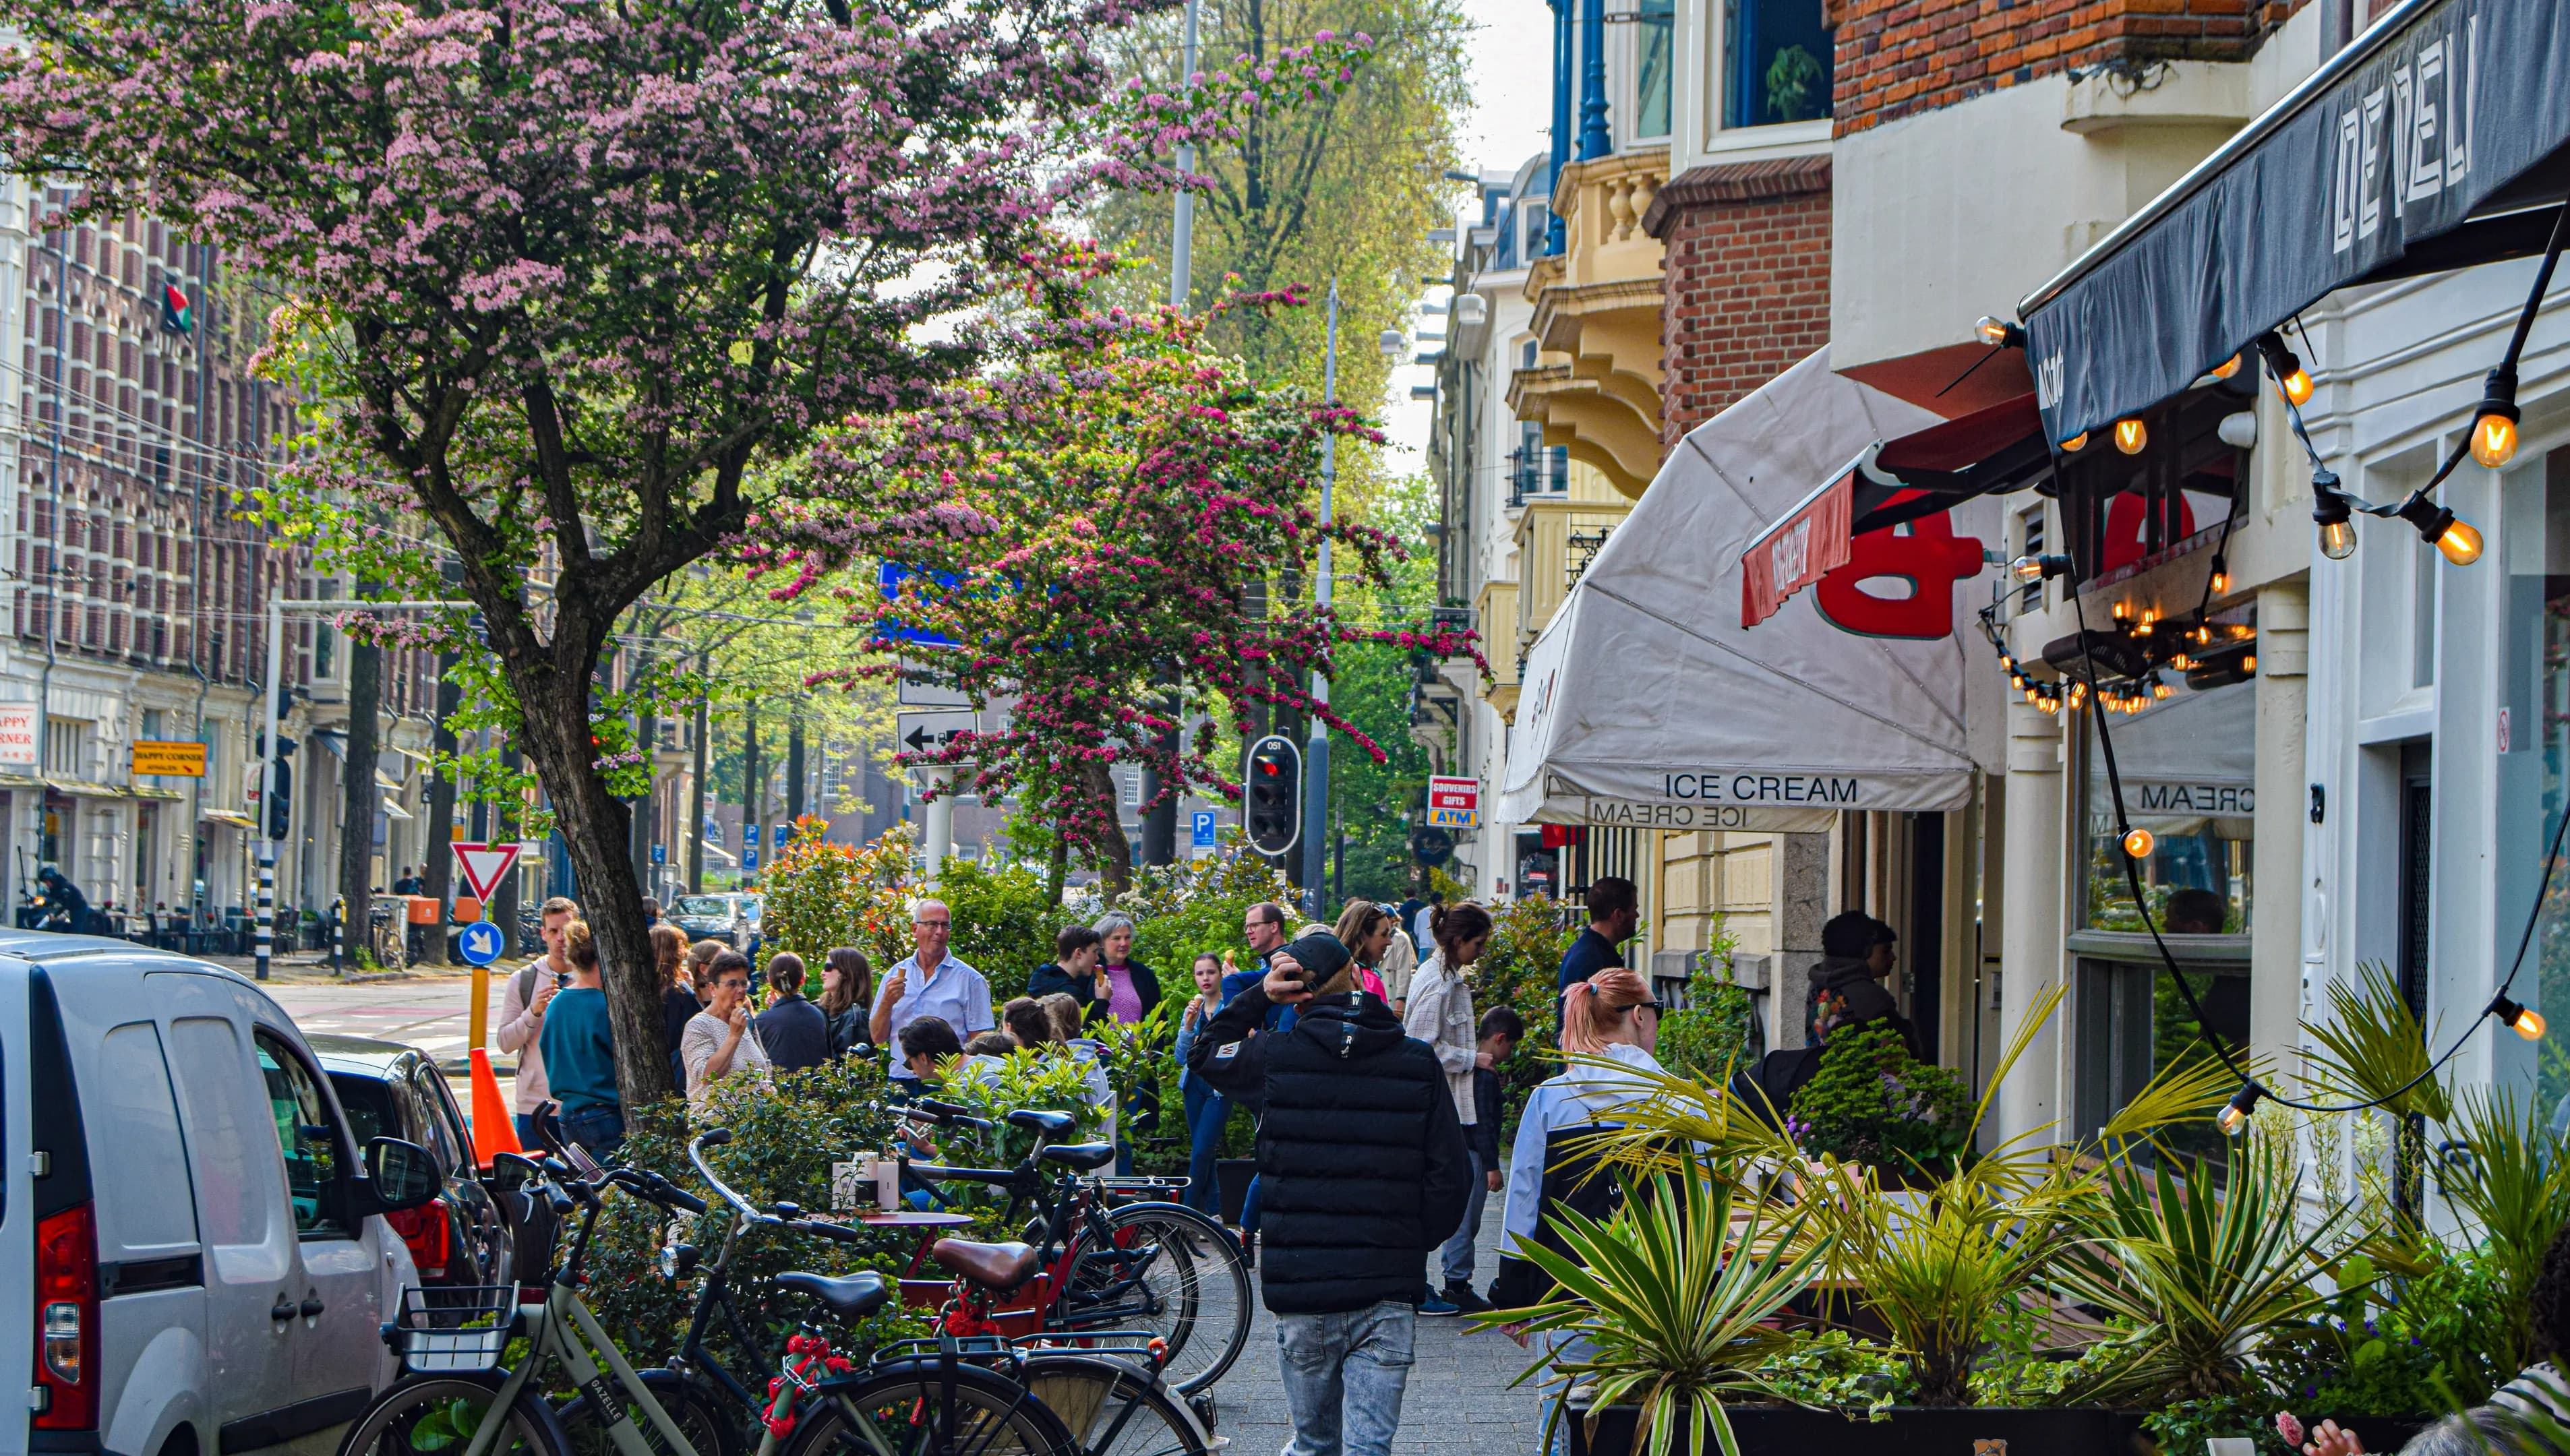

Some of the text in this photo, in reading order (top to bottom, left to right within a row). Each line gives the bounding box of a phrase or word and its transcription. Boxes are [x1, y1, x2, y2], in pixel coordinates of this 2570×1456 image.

[1267, 741, 1281, 750] 051
[1433, 783, 1476, 793] SOUVENIRS
[1666, 774, 1857, 803] ICE CREAM
[1443, 795, 1466, 806] GIFTS
[1197, 814, 1210, 832] P
[1437, 811, 1471, 824] ATM
[591, 1379, 622, 1420] GAZELLE
